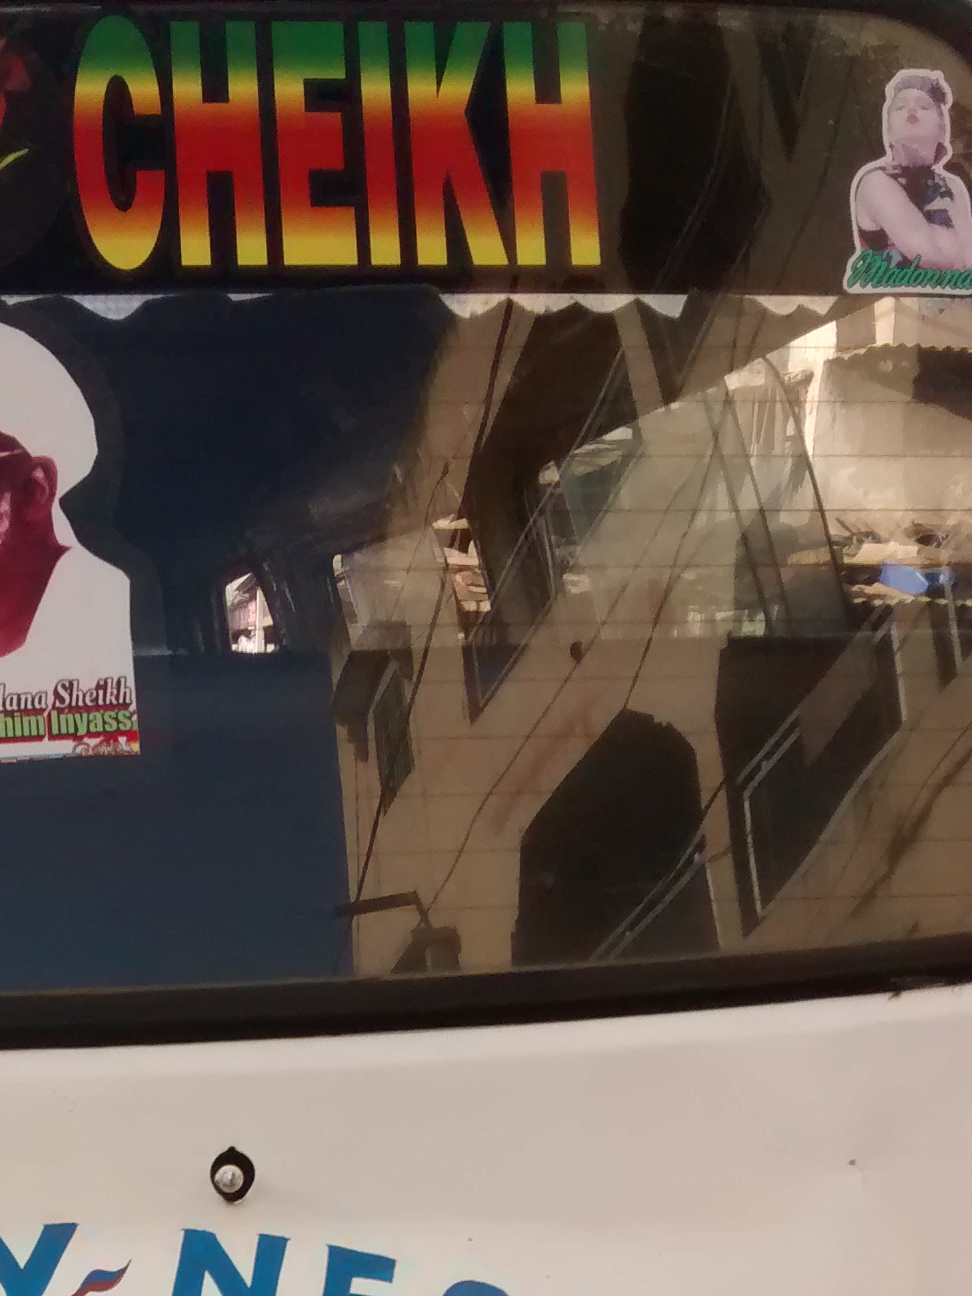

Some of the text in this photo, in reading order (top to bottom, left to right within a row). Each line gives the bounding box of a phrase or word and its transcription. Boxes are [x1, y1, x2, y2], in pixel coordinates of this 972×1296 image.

[73, 15, 602, 272] CHEIKH
[54, 676, 134, 710] Sheikh
[50, 708, 134, 738] Inyass
